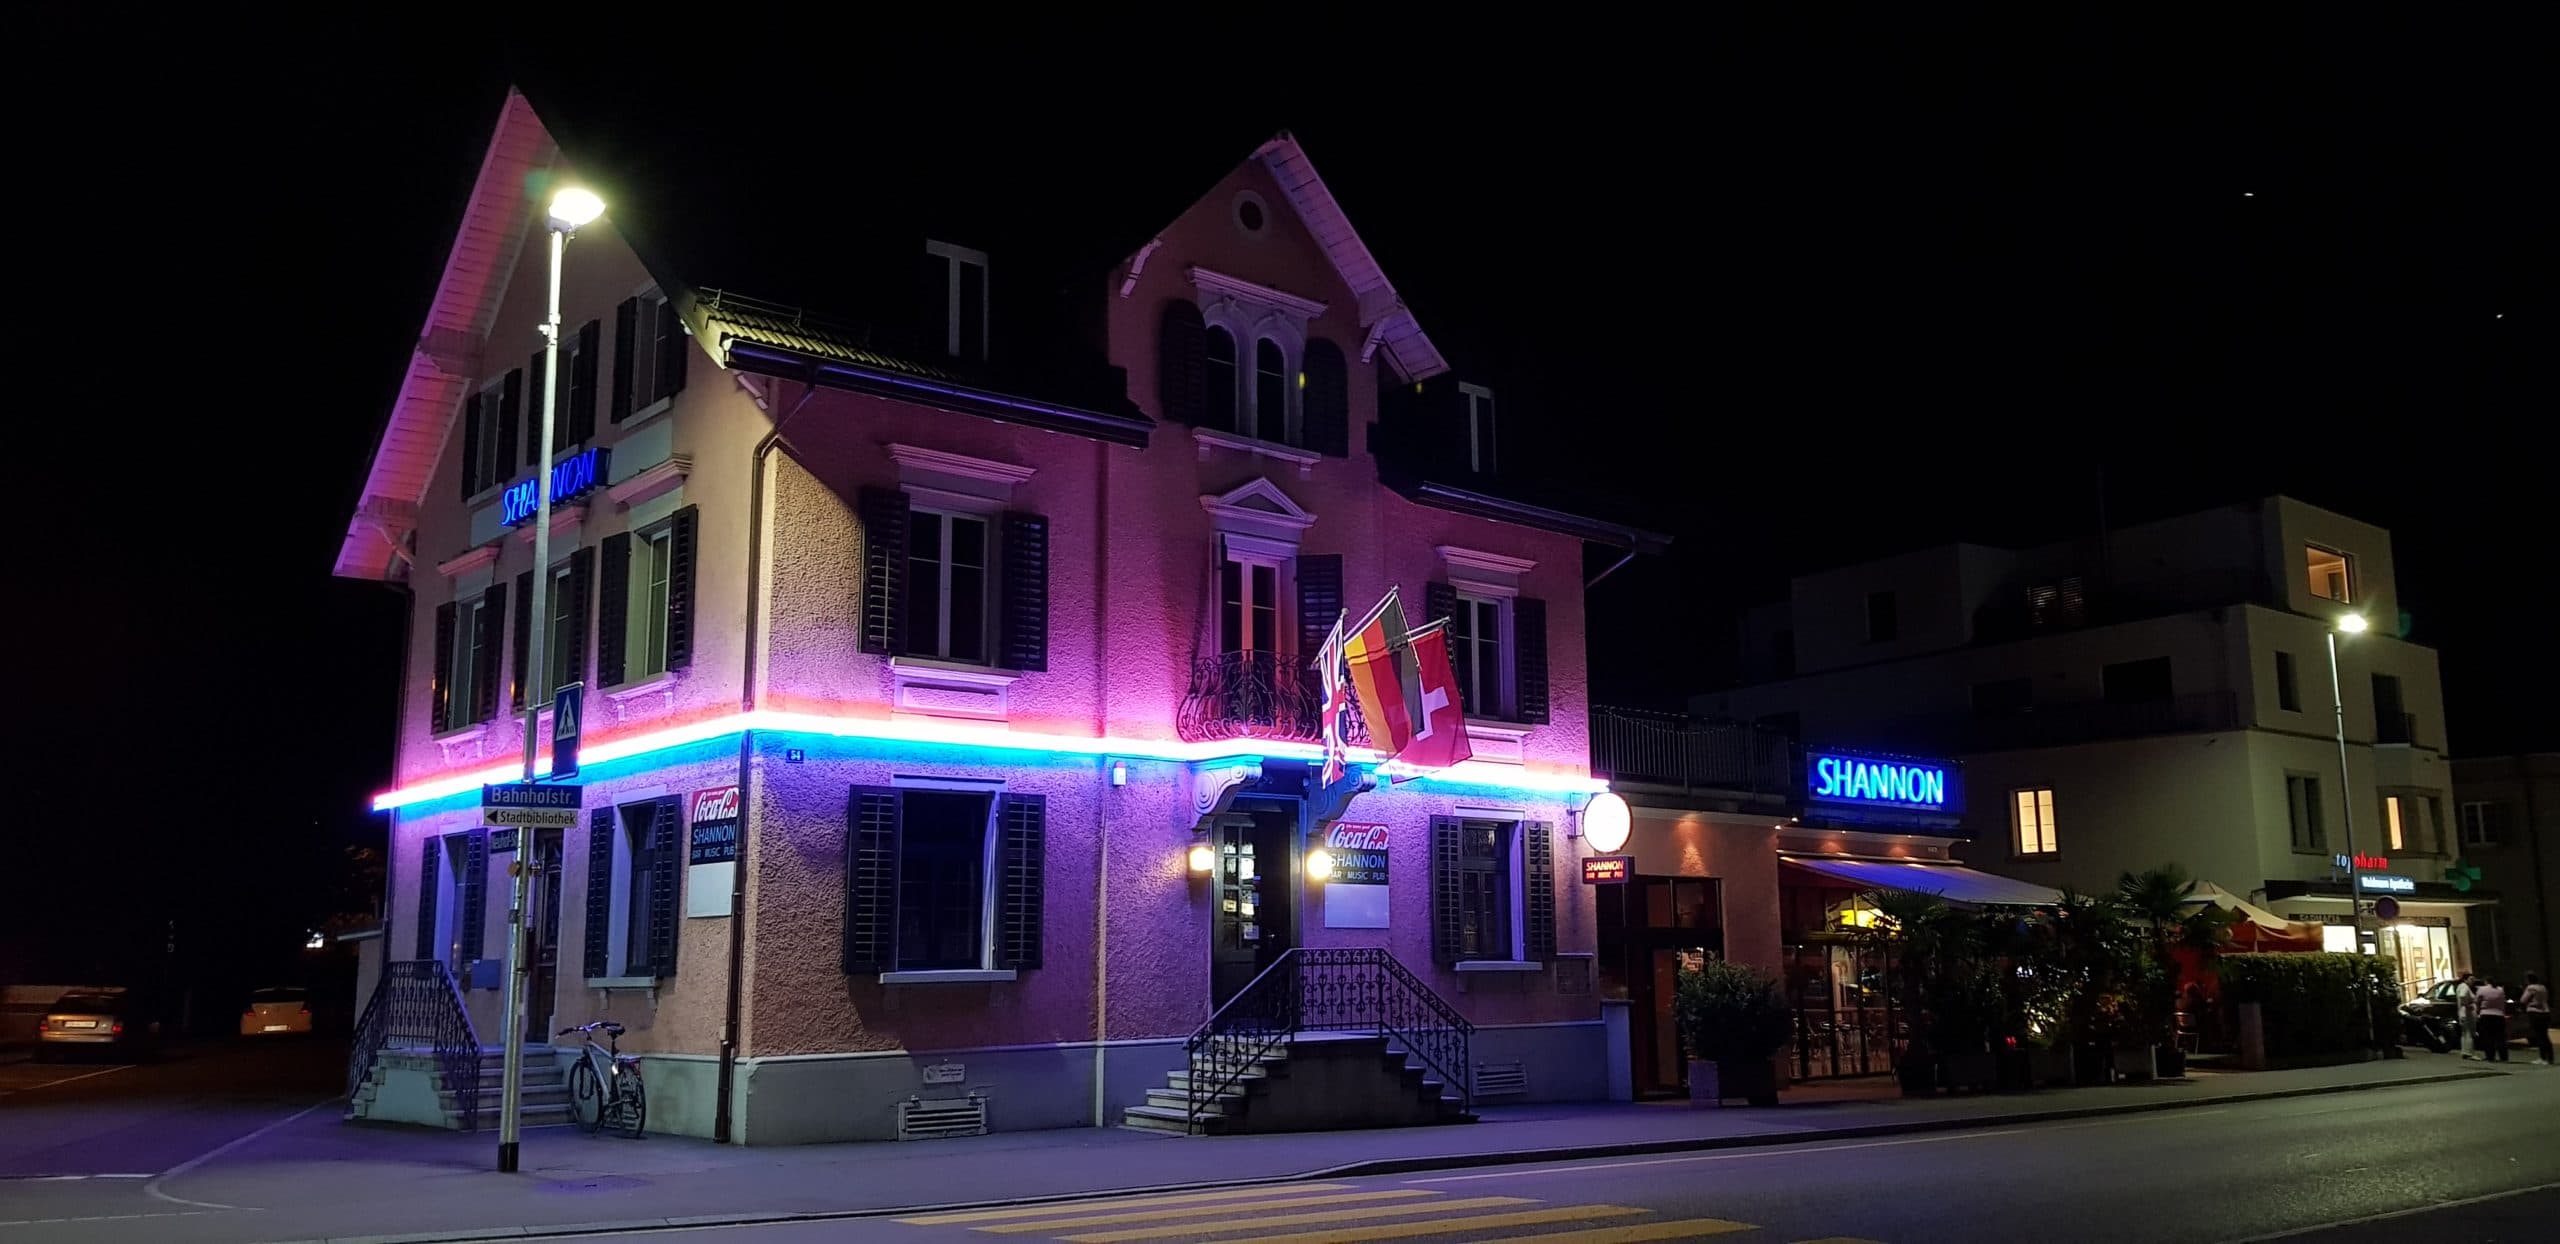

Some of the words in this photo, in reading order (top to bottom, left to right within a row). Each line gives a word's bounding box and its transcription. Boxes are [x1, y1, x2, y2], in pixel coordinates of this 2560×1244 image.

[502, 447, 597, 525] SHANON
[1817, 758, 1943, 804] SHANNON
[491, 786, 574, 805] Bahnhofstr.
[500, 810, 575, 825] Stadtbibliothek
[693, 824, 736, 845] SHANNON
[724, 846, 735, 856] PUB
[1331, 853, 1386, 869] SHANNON
[1586, 860, 1624, 871] SHANNON
[1347, 871, 1369, 880] MUSIC
[1373, 872, 1386, 881] PUB
